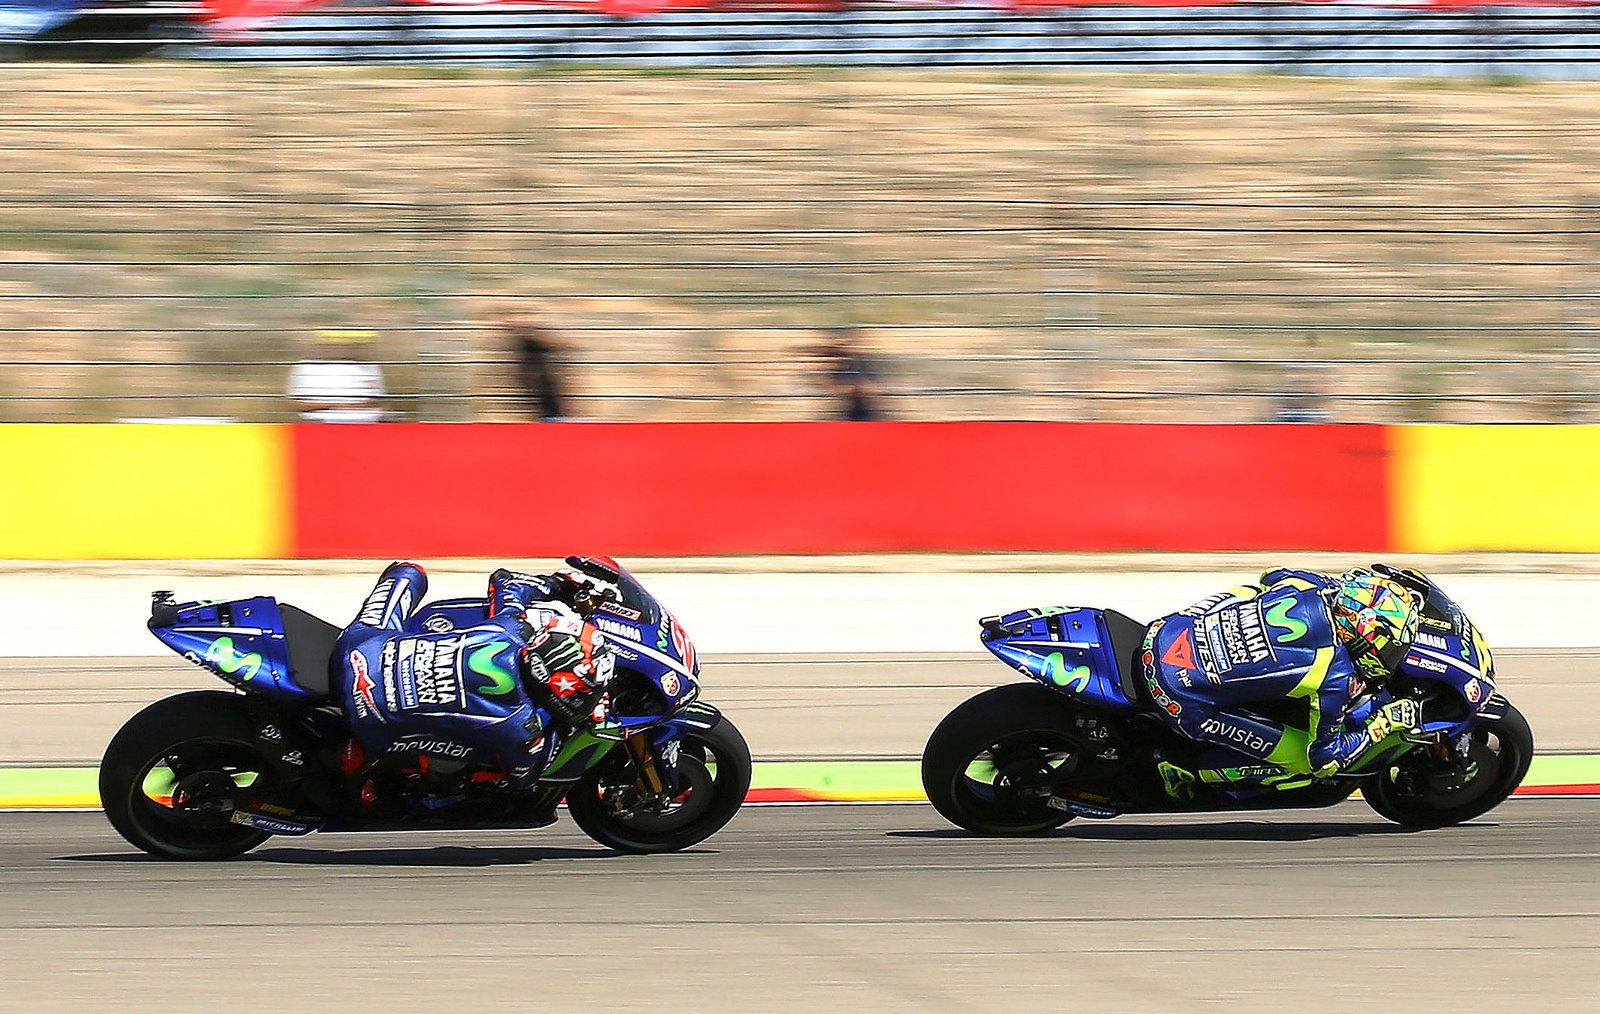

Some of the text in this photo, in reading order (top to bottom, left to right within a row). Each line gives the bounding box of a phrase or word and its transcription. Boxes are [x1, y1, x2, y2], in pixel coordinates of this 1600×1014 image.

[596, 617, 642, 642] YAMAHA
[1193, 614, 1222, 685] DAINESE
[1222, 621, 1242, 665] DEPAN
[1229, 609, 1250, 664] SEMAKIN
[1239, 601, 1270, 664] YAMAHA
[1414, 631, 1448, 651] AMAHA
[434, 637, 458, 704] YAMAHA
[1142, 650, 1182, 717] DOCTOR
[387, 740, 474, 758] movistar
[1200, 719, 1274, 753] movistar
[256, 819, 305, 832] MICHELIN
